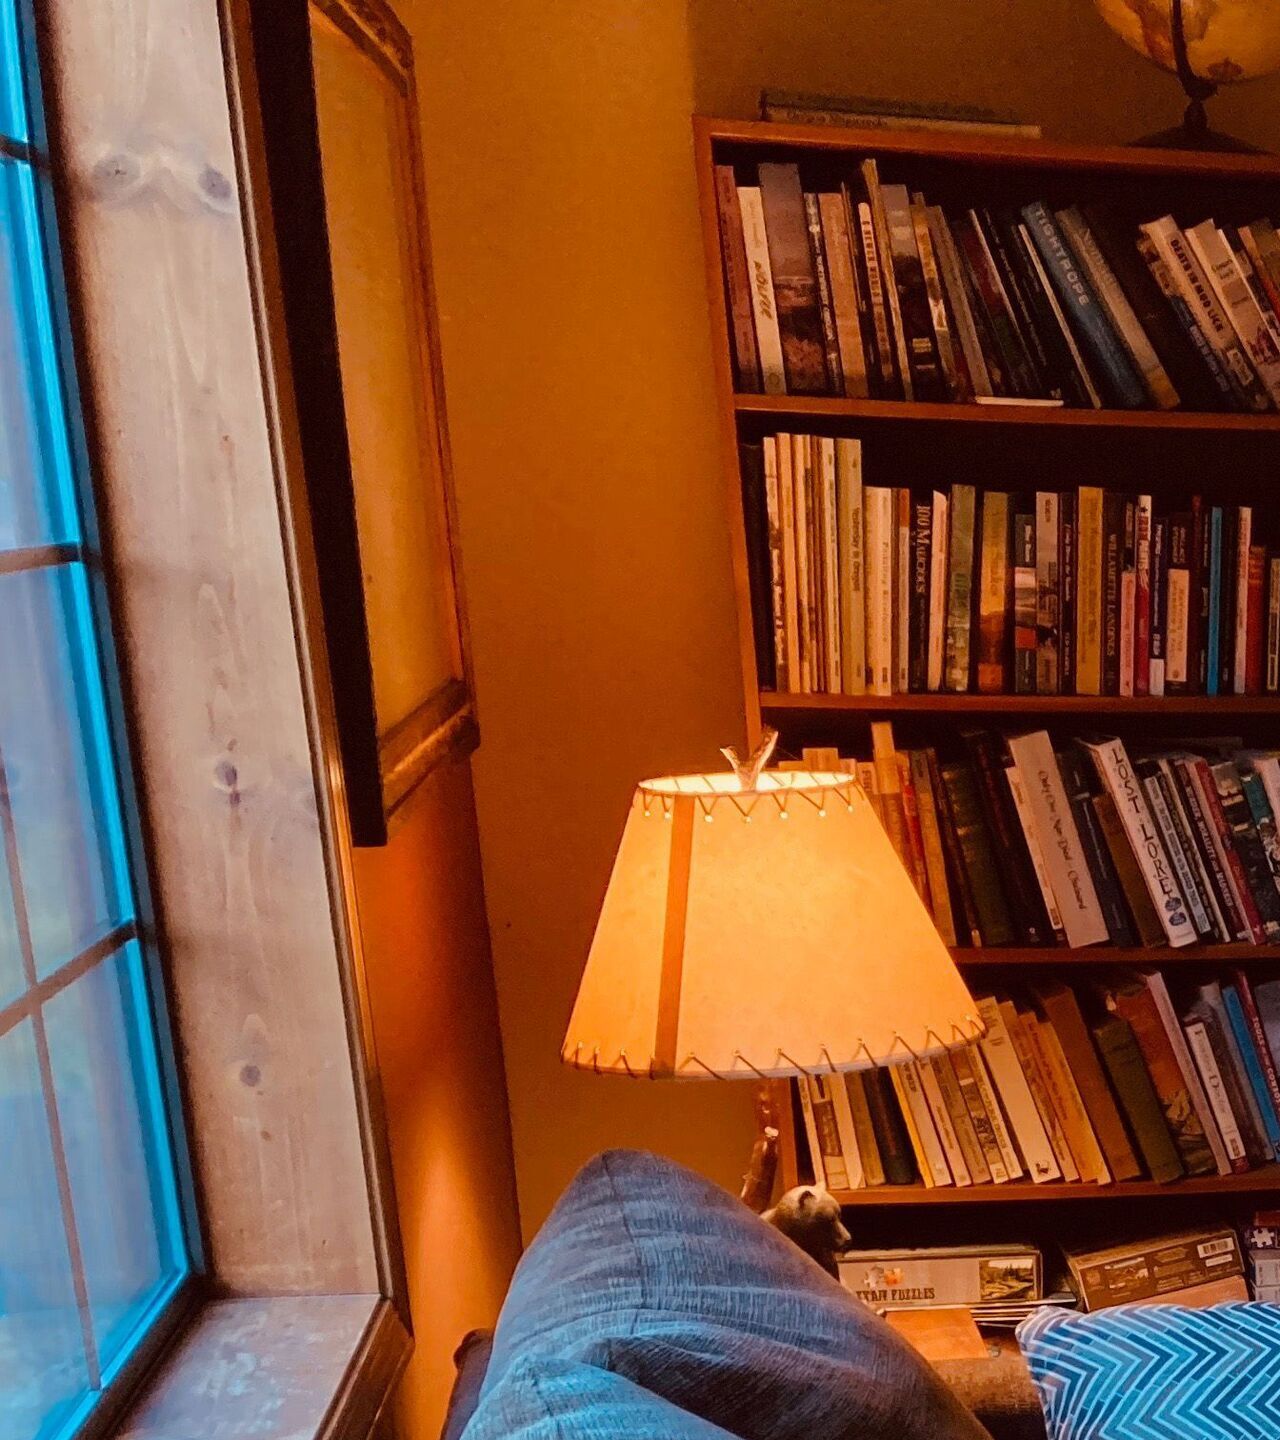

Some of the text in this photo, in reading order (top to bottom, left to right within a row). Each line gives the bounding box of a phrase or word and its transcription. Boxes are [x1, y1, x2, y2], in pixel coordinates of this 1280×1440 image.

[1031, 207, 1091, 307] TIGHTROPE
[1106, 533, 1117, 655] WILLAMETTE LANDINGS
[1110, 745, 1172, 895] LOST LORE
[891, 1288, 935, 1301] PUZZLES
